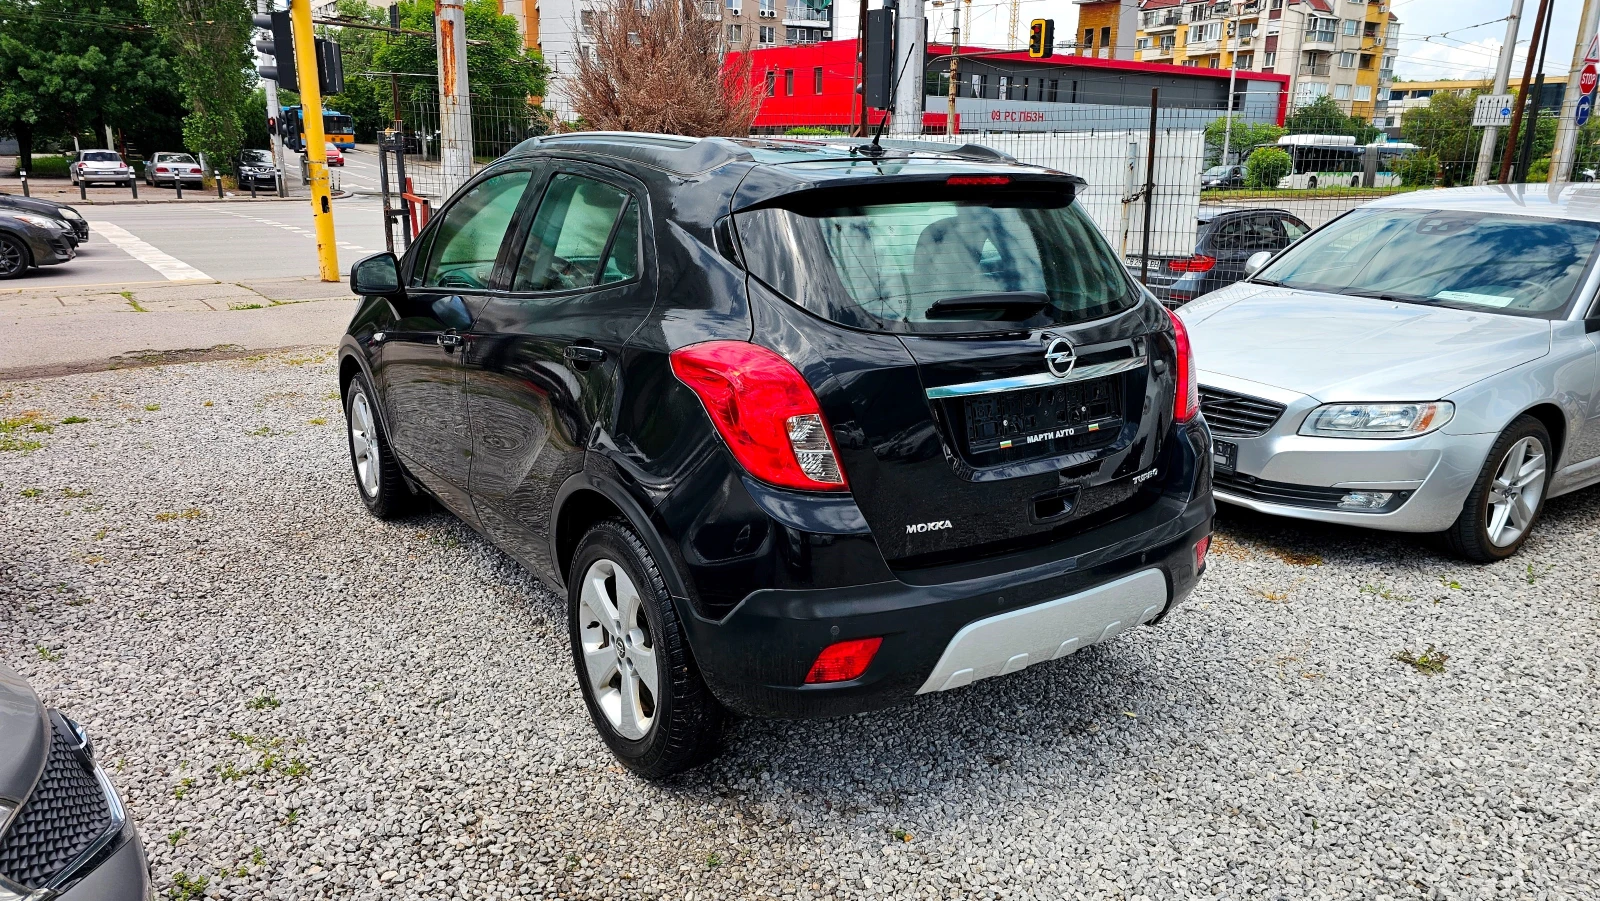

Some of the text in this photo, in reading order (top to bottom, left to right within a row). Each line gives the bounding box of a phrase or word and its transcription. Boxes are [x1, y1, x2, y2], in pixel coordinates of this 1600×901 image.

[1581, 73, 1596, 85] STOP
[991, 110, 1044, 122] 09 РС ПБЗН
[1027, 428, 1075, 444] МАРТИ АУТО
[906, 519, 953, 534] MOKKA
